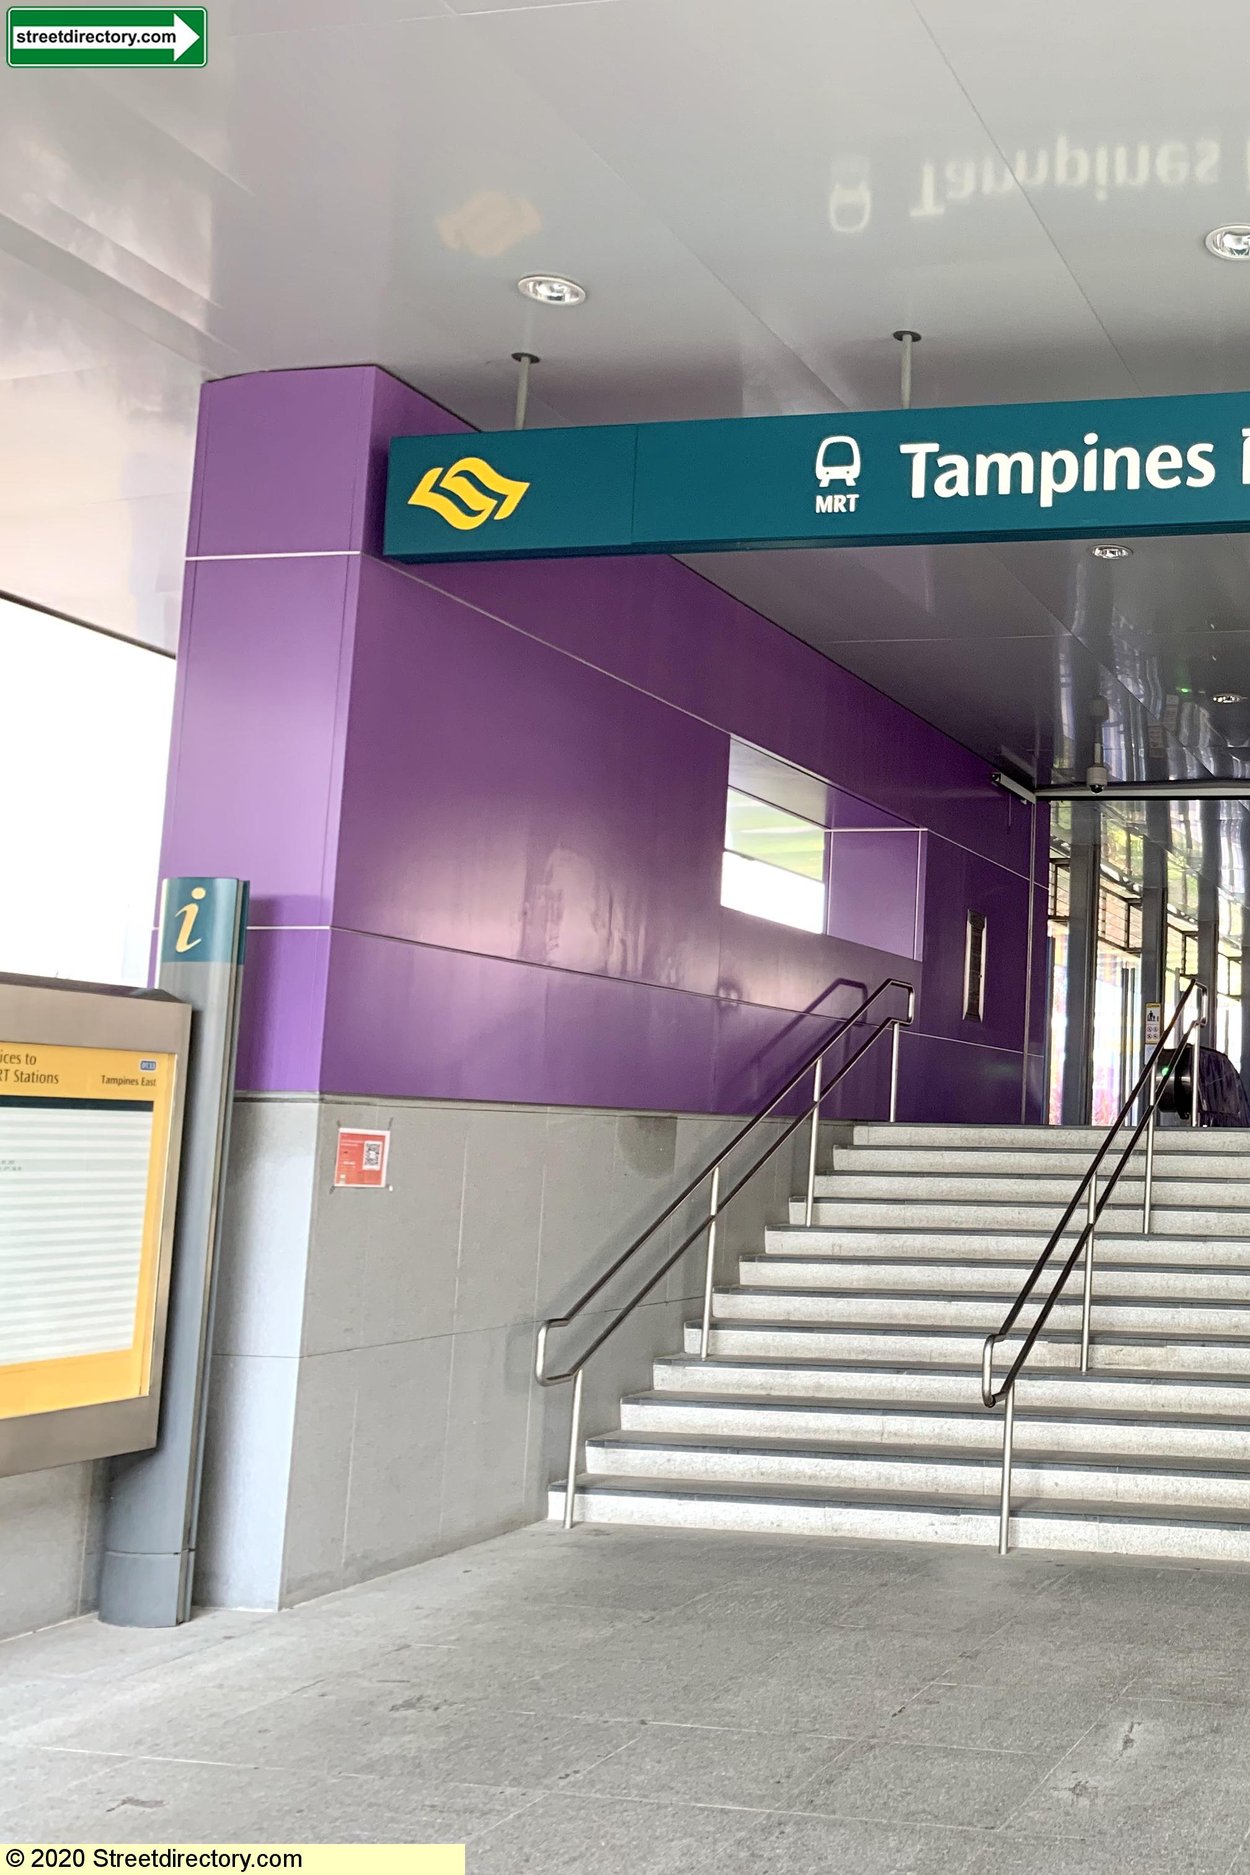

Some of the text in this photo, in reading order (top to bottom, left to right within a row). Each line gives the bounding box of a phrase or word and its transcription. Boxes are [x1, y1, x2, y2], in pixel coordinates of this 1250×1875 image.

[899, 432, 1216, 508] Tampines
[815, 494, 860, 514] MRT
[25, 1053, 37, 1066] to
[13, 1069, 59, 1085] Stations
[101, 1074, 156, 1087] Tampines East
